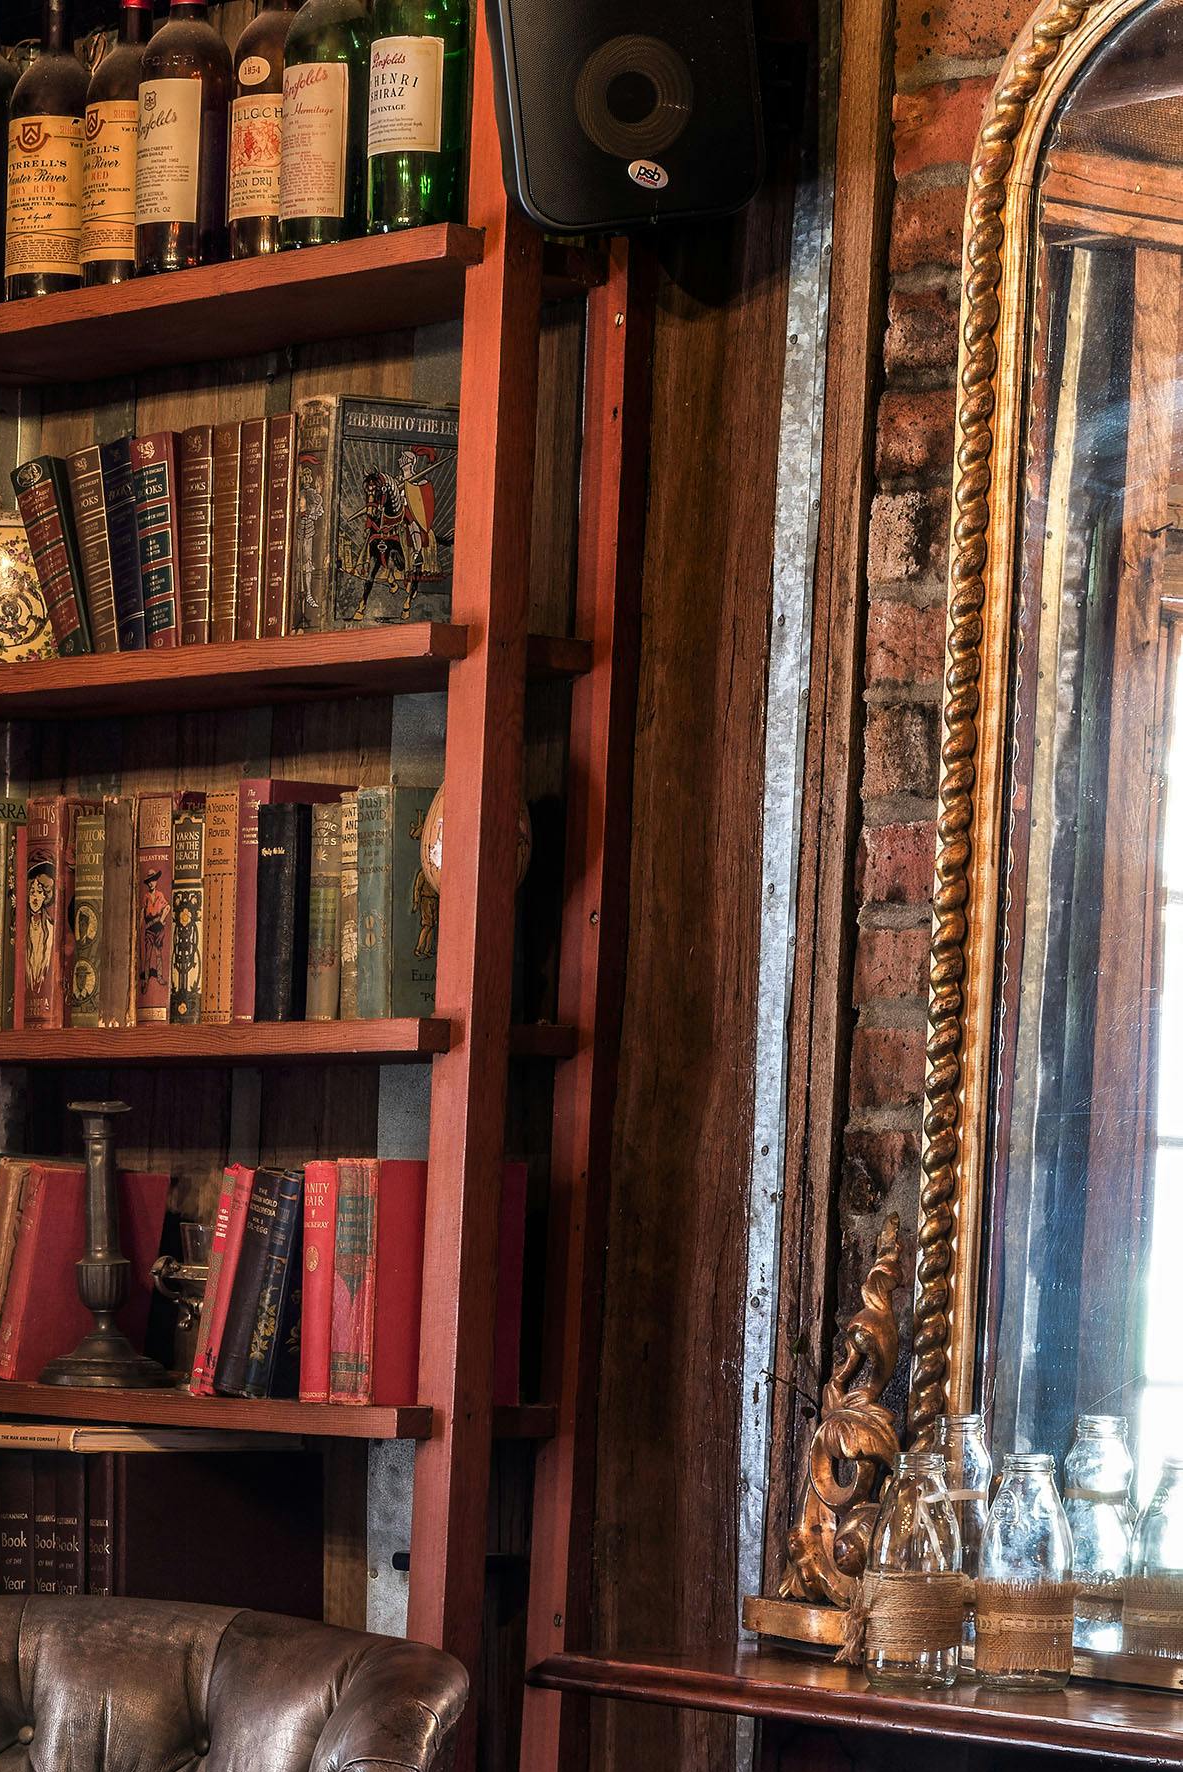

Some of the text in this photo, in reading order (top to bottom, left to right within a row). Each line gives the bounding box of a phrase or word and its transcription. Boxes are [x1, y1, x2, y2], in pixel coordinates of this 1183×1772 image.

[371, 51, 406, 70] Penfolds
[244, 66, 261, 76] 1954
[374, 72, 419, 88] HENRI
[370, 86, 405, 102] SHIRAZ
[291, 102, 334, 118] Hermitage
[377, 103, 406, 113] VINTAGE
[92, 156, 121, 169] River
[34, 168, 68, 183] River
[90, 172, 109, 182] RED
[635, 165, 661, 184] psb
[252, 177, 272, 187] DRY
[33, 186, 56, 194] RED
[347, 411, 438, 435] THE RIGHT THE
[146, 802, 162, 816] THE
[211, 803, 235, 814] YOUNG
[359, 797, 383, 809] JUST
[358, 809, 387, 822] DAVID
[176, 831, 200, 841] YARNS
[208, 828, 231, 838] ROVER
[82, 842, 93, 853] OR
[176, 841, 200, 850] ON THE
[176, 850, 199, 861] BEACH
[206, 858, 230, 869] Spencer
[263, 1197, 278, 1208] WORLD
[305, 1195, 325, 1207] FAIR
[1, 1530, 28, 1548] Book
[3, 1575, 26, 1590] Year
